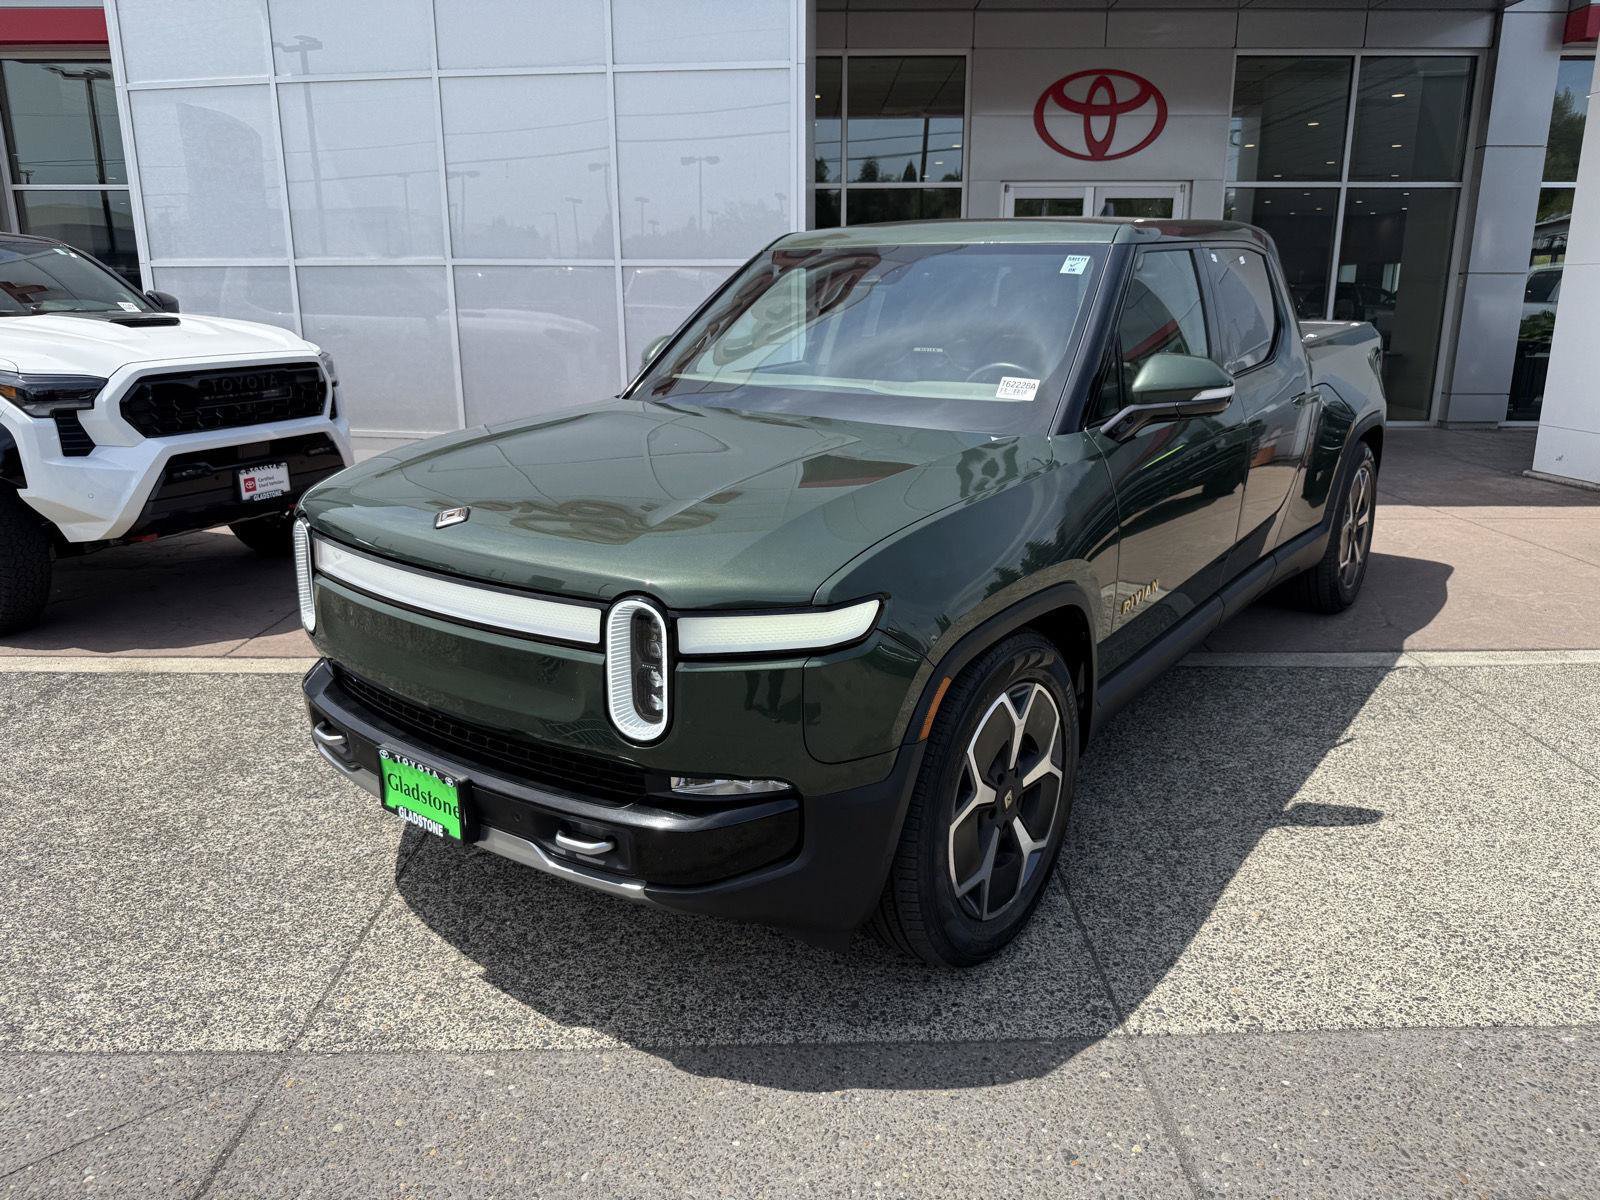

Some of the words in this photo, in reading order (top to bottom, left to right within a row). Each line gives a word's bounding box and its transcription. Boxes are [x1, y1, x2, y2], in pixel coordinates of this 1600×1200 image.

[209, 373, 278, 392] TOYOTA
[250, 464, 278, 473] TOYOTA
[253, 489, 284, 501] GLADSTONE
[1121, 578, 1159, 614] RIVIAN
[394, 754, 439, 779] TOYOTA
[387, 773, 461, 819] Gladstone
[398, 806, 444, 837] GLADSTONE
